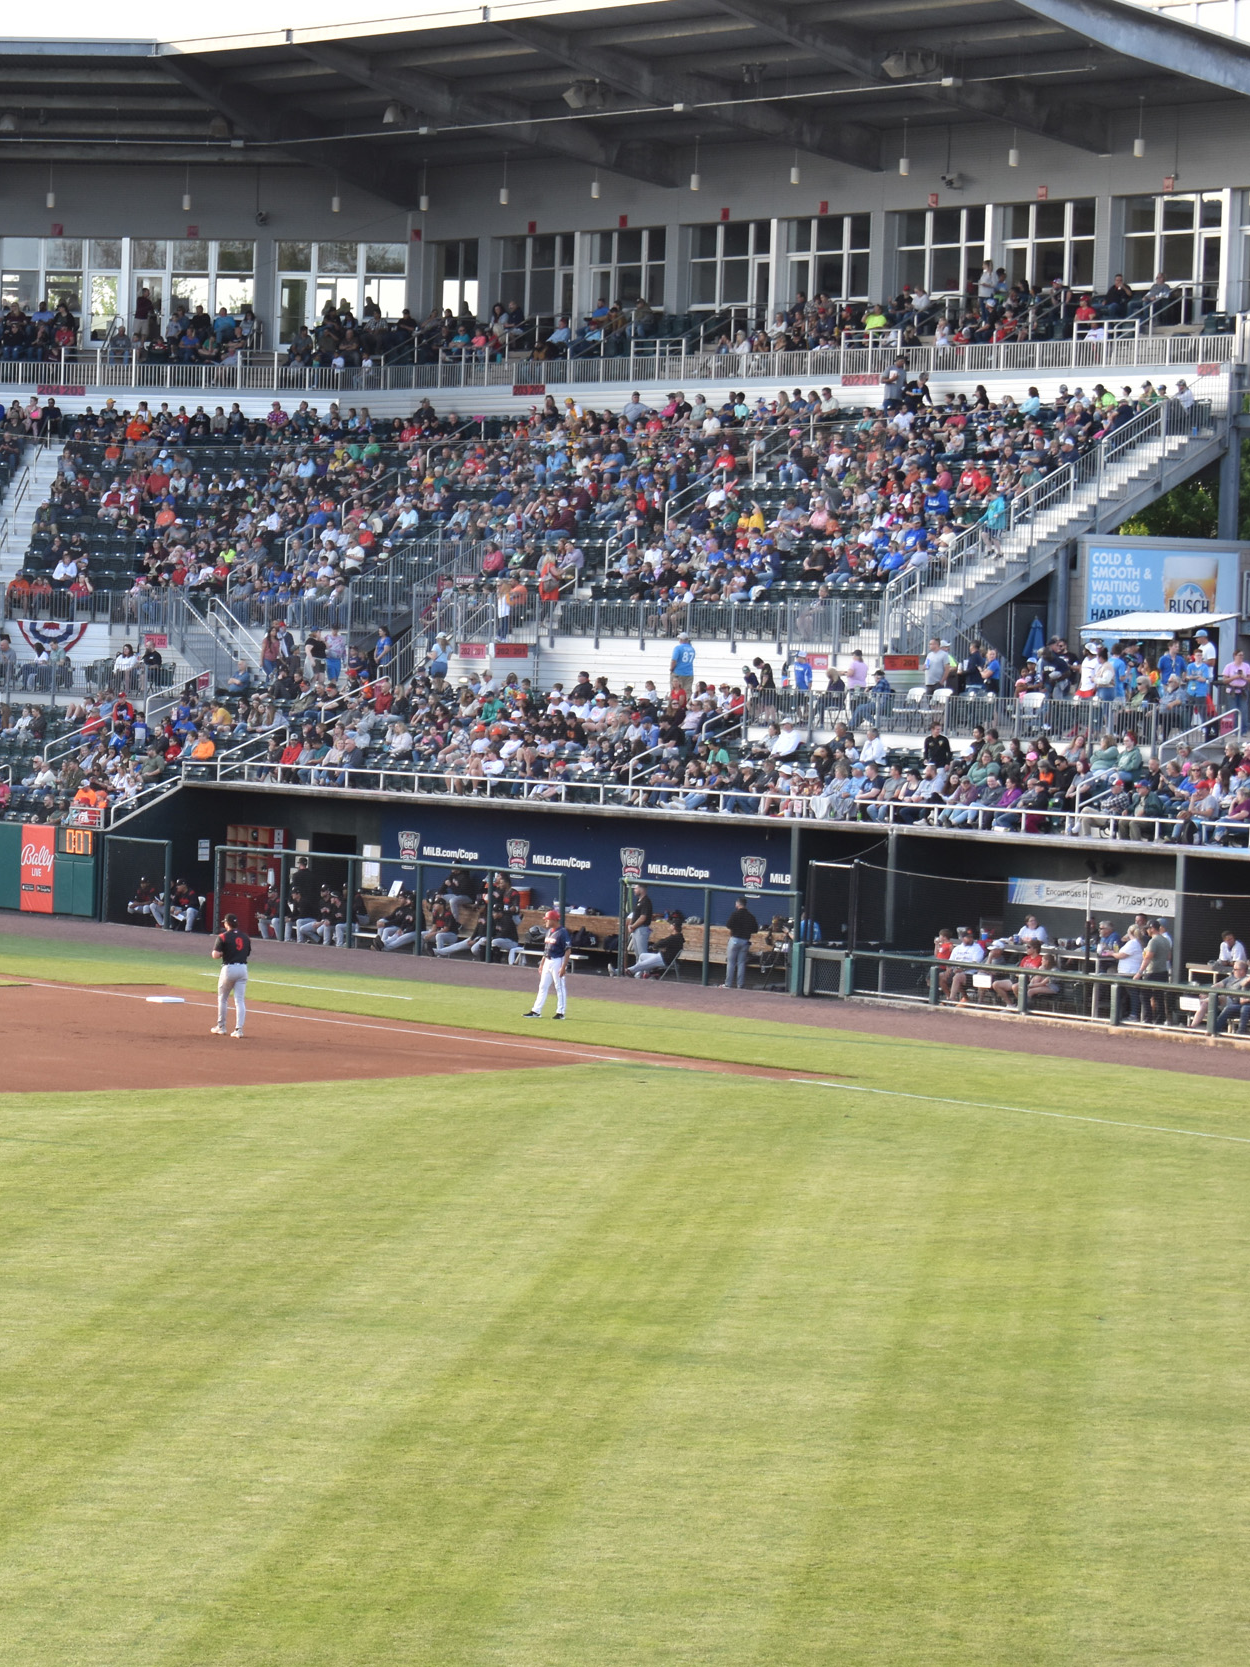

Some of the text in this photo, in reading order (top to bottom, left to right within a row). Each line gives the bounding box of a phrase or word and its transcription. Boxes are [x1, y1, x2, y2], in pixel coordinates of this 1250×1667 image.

[1092, 552, 1133, 566] COLD &
[1092, 566, 1152, 580] SMOOTH &
[1091, 580, 1140, 593] WAITING
[1091, 594, 1144, 608] FOR YOU,
[1169, 599, 1210, 613] BUSCH
[682, 651, 695, 663] 87
[66, 829, 92, 854] 0:07
[21, 843, 54, 872] Bally
[422, 846, 479, 861] MiLB.com/Copa
[532, 855, 592, 870] MiLB.com/Copa
[31, 867, 42, 877] LIVE
[647, 864, 710, 879] MiLB.com/Copa
[1082, 889, 1104, 899] Halth
[1116, 894, 1169, 908] 717.6913700
[235, 937, 244, 951] 9
